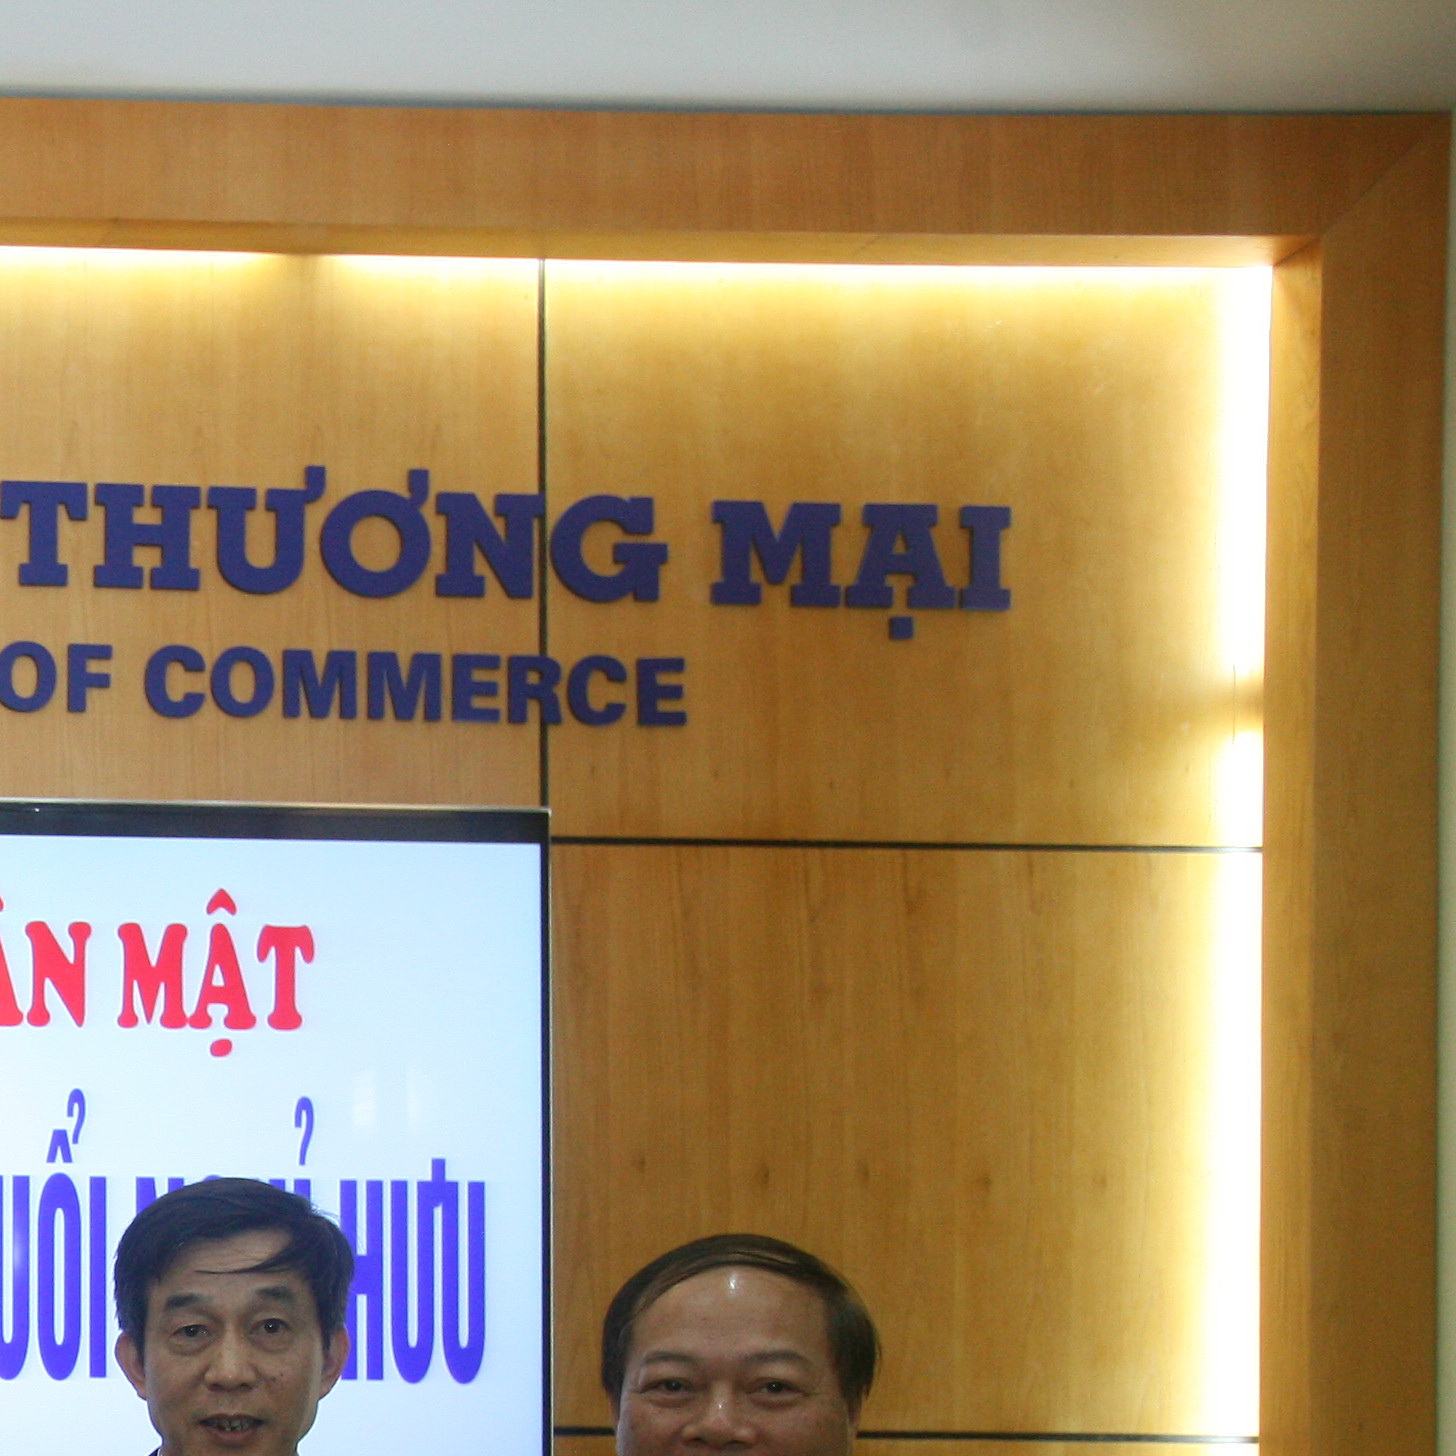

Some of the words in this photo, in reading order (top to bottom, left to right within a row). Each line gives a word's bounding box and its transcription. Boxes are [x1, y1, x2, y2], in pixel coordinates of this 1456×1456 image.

[1, 466, 667, 602] THƯƠNG
[712, 501, 1013, 640] MẠI
[145, 645, 687, 727] COMMERCE
[119, 888, 316, 1057] MẬT
[338, 1157, 487, 1385] HƯU
